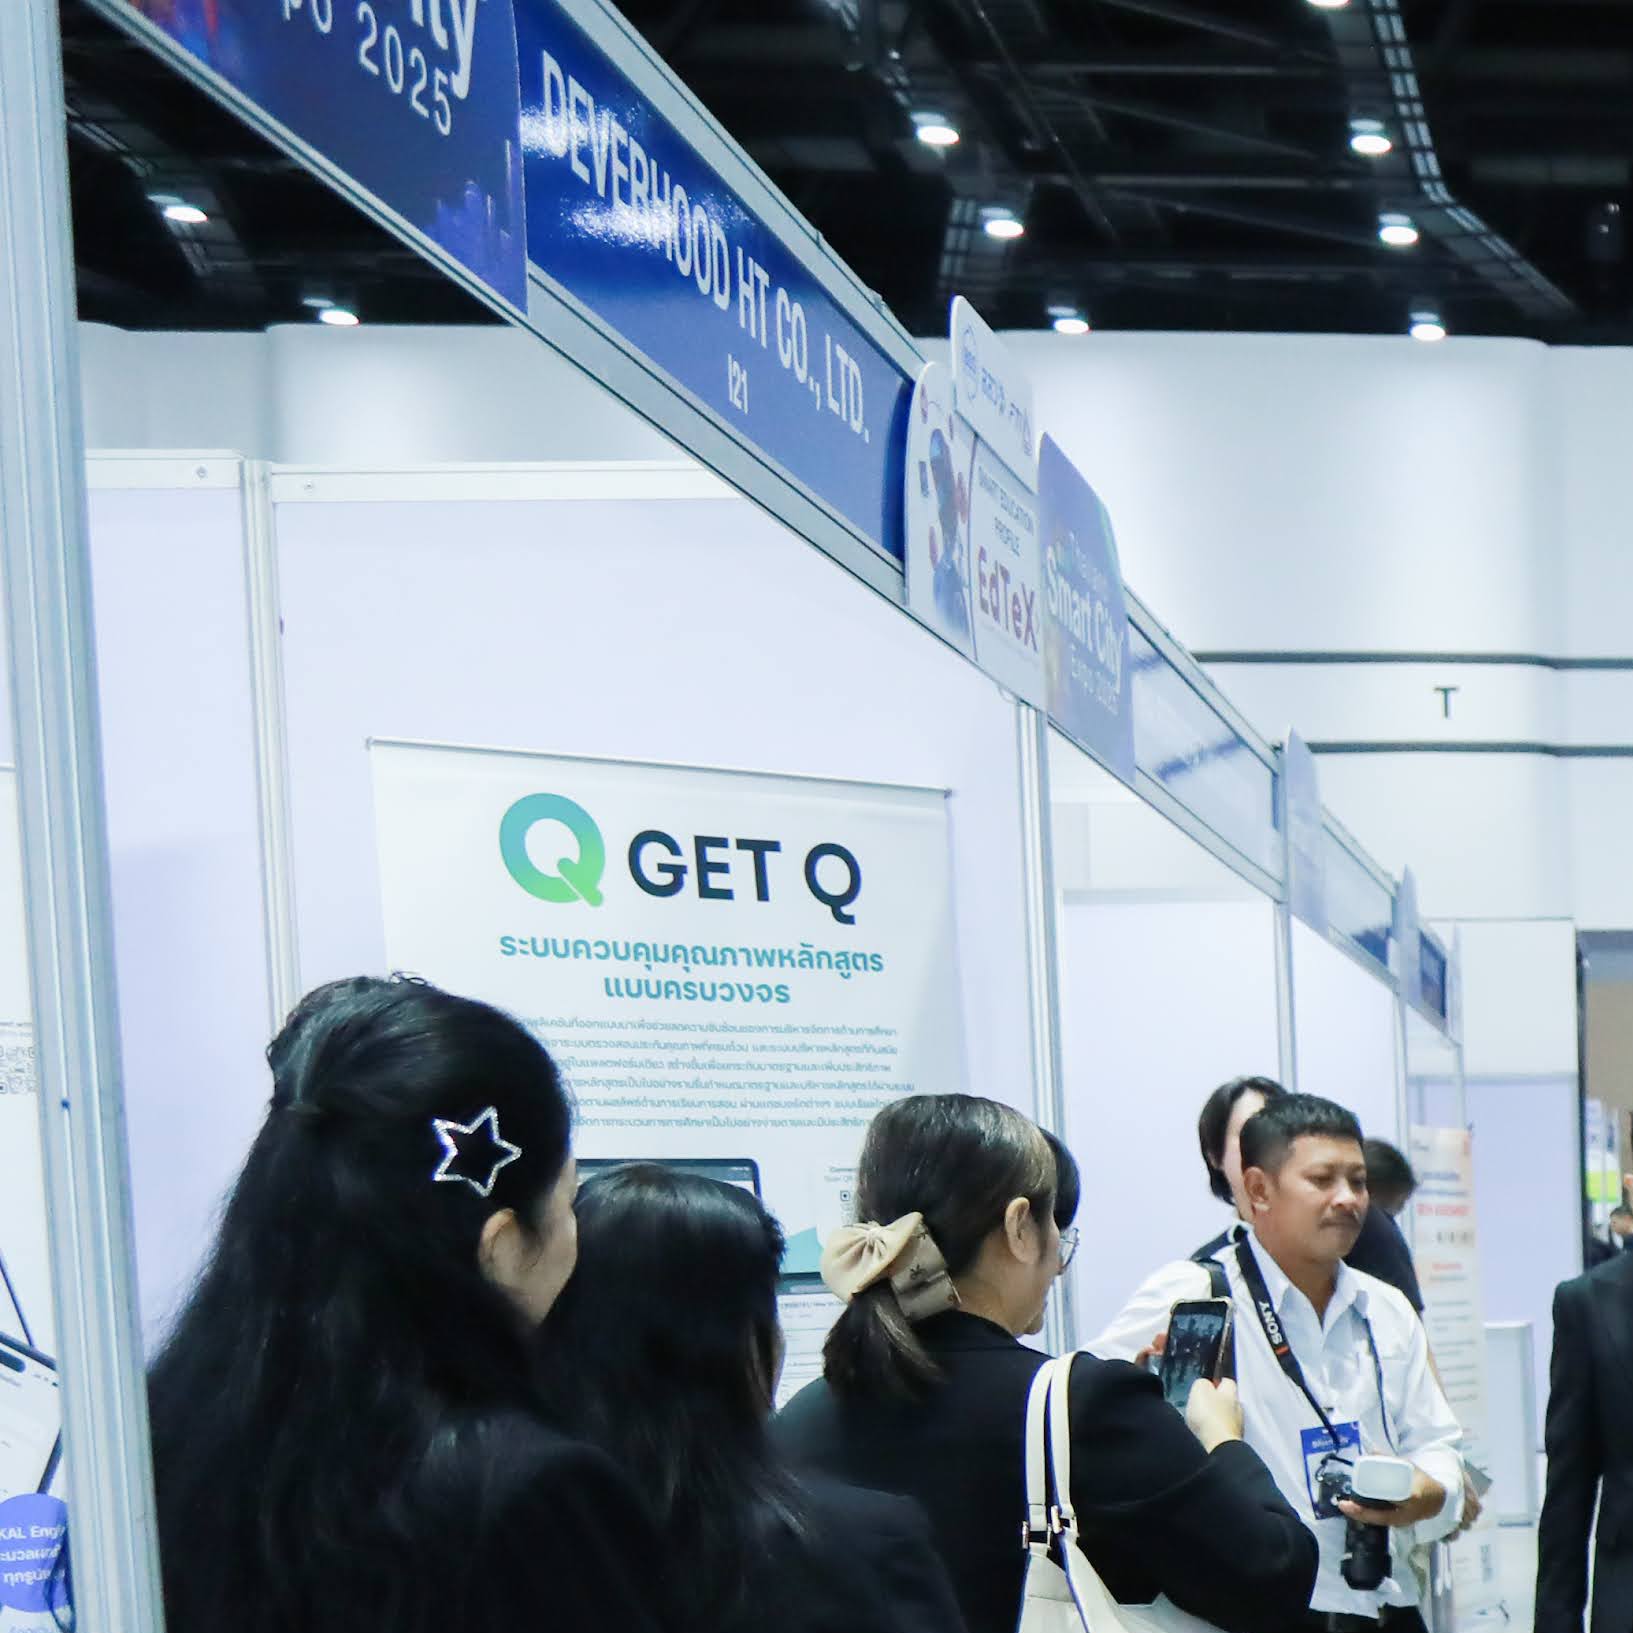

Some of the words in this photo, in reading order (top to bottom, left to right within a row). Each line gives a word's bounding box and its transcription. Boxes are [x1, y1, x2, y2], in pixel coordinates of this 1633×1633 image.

[357, 1, 452, 137] 2025
[542, 48, 731, 311] DEVERHOOD
[737, 246, 769, 349] HT
[775, 287, 821, 411] CO.,
[825, 333, 869, 443] LTD.
[977, 544, 1037, 652] EdTeX
[1046, 544, 1093, 654] Smart
[1434, 687, 1459, 718] T
[627, 829, 782, 902] GET
[803, 842, 863, 926] Q
[499, 934, 884, 980] ระบบควบคุมคุณภาพหลักสูตร
[603, 975, 791, 1004] แบบครบวงจร
[1258, 1300, 1284, 1345] SONY
